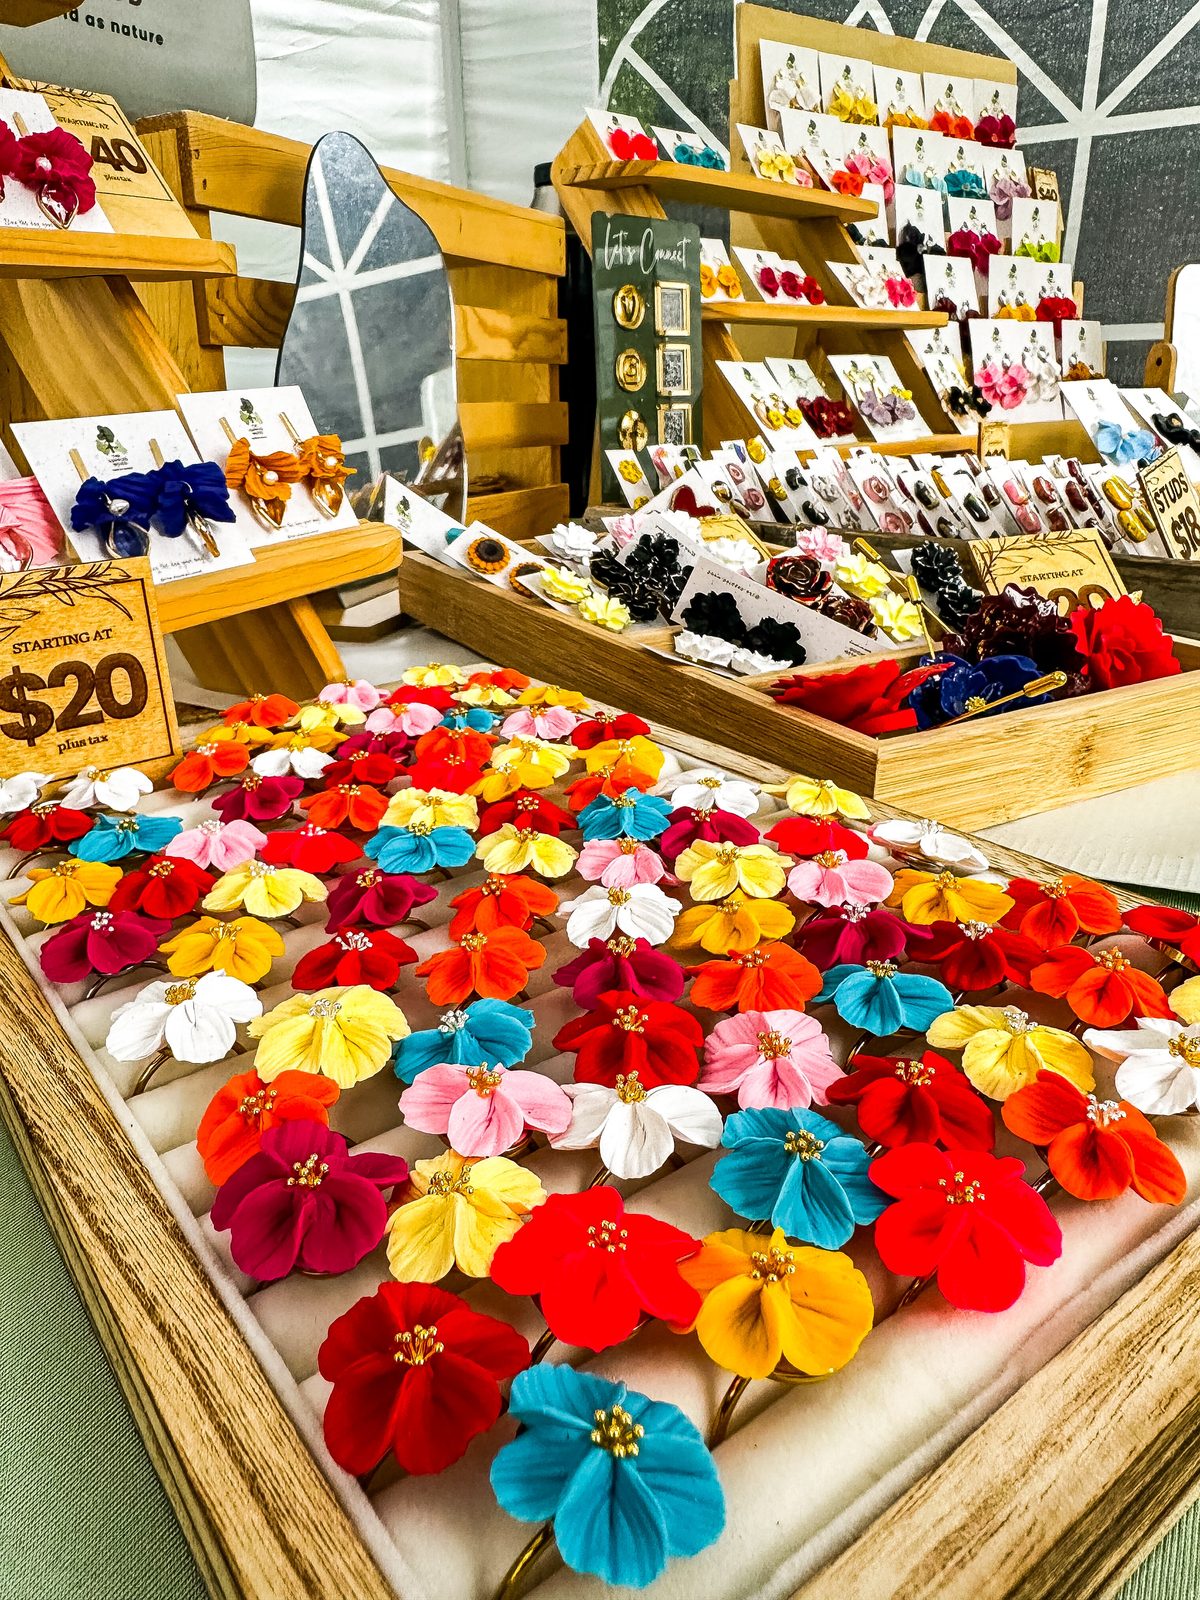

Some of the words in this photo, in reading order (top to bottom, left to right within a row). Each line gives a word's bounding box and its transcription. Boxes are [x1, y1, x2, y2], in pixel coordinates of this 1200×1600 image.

[85, 14, 105, 29] as
[110, 21, 164, 46] nature
[90, 135, 147, 174] 40
[639, 227, 692, 275] Connect
[1153, 471, 1189, 514] STUDS
[1171, 505, 1200, 560] $18
[1019, 570, 1070, 583] STARTING
[1071, 568, 1084, 577] AT
[12, 631, 91, 655] STARTING
[92, 628, 113, 641] AT
[0, 652, 149, 747] $20
[57, 737, 87, 755] plus
[88, 734, 109, 746] tax
